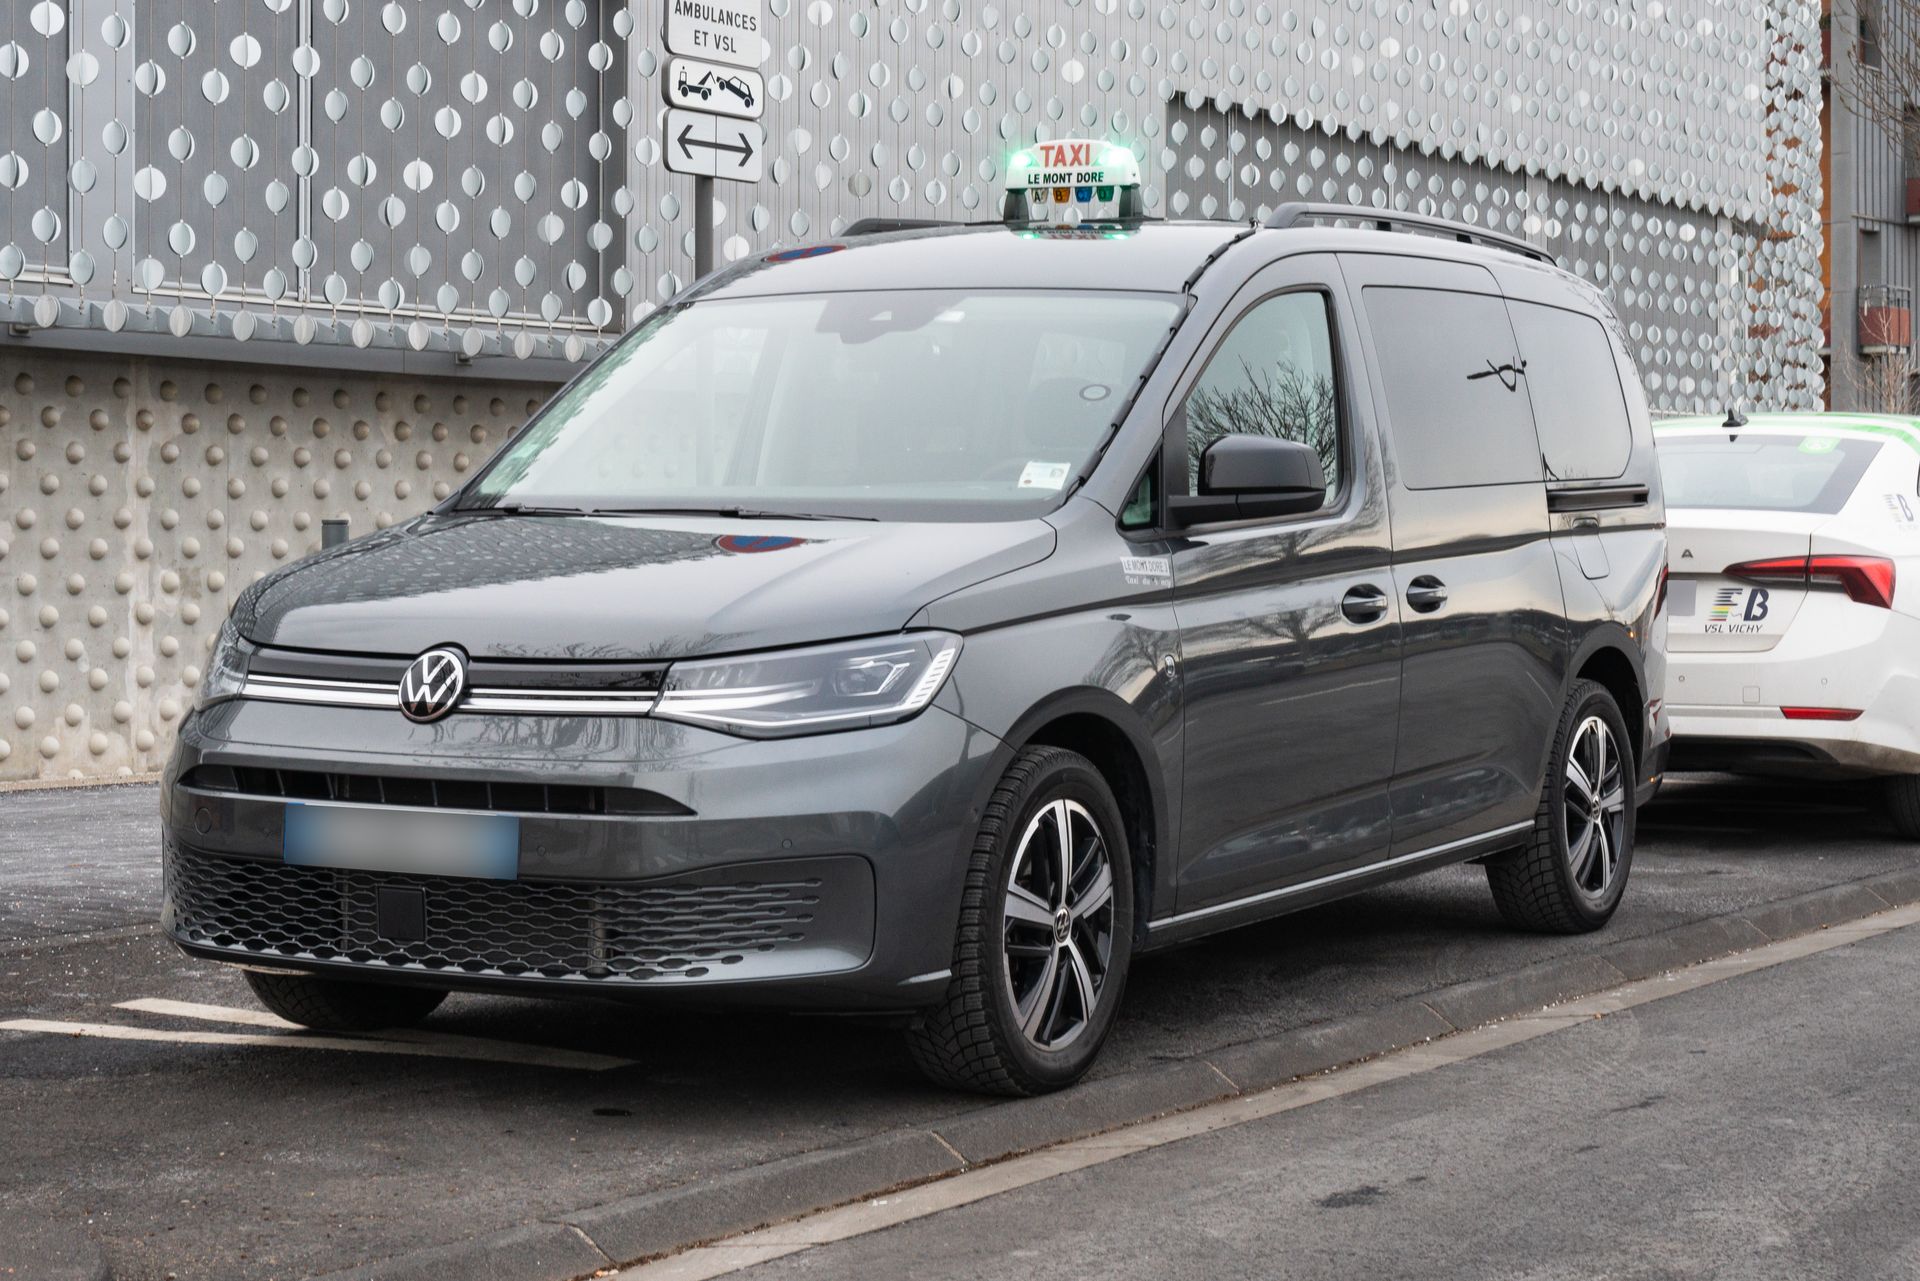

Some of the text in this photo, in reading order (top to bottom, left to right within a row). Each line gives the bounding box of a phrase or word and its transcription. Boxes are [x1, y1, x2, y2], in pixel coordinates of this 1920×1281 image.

[674, 0, 757, 31] AMBULANCES
[694, 29, 737, 53] ET VSL
[1039, 143, 1091, 168] TAXI
[1028, 171, 1105, 185] LE MONT DORE
[1704, 624, 1763, 633] VSL VICHY
